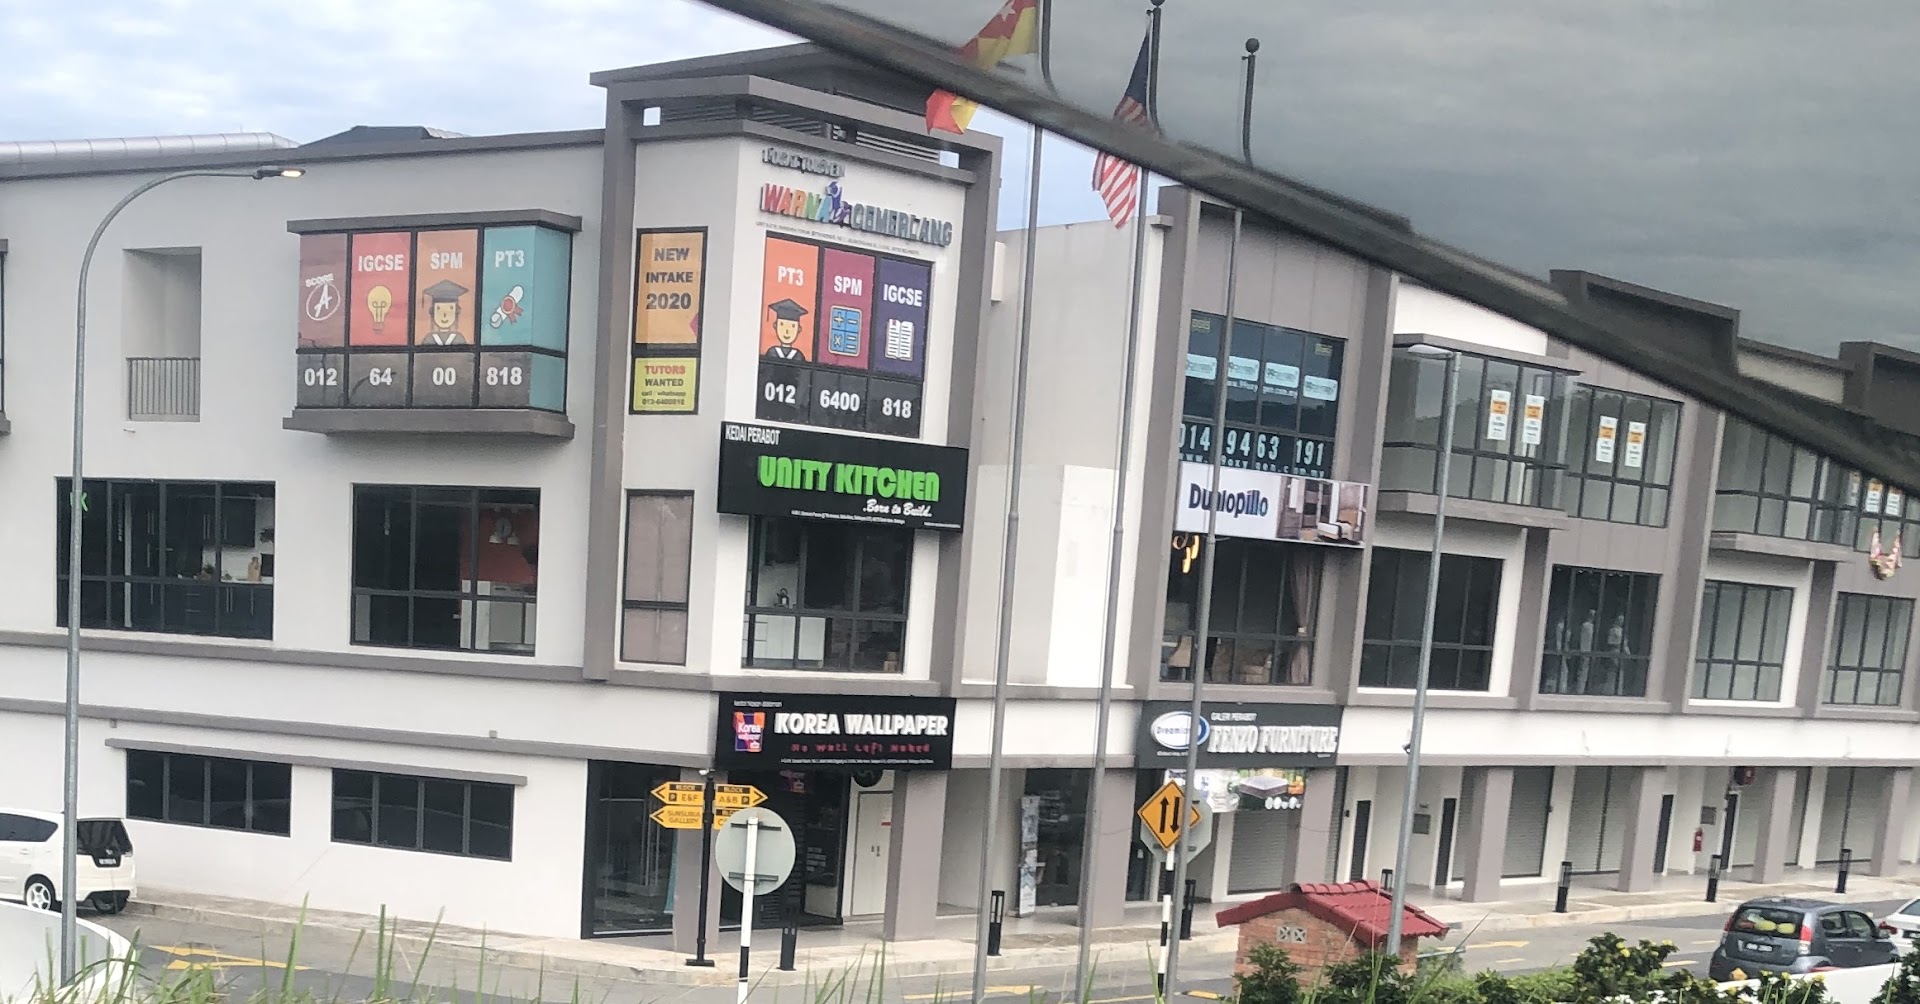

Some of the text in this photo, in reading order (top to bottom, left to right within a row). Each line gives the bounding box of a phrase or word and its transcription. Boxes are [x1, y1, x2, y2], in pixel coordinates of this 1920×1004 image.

[760, 183, 833, 223] WARNA
[851, 203, 953, 247] CEMERLANG
[358, 254, 404, 272] IGCSE
[430, 252, 463, 270] SPM
[495, 250, 525, 268] PT3
[654, 248, 690, 262] NEW
[305, 273, 335, 287] SCORE
[646, 272, 694, 284] INTAKE
[777, 265, 804, 287] PT3
[834, 275, 863, 297] SPM
[883, 283, 923, 307] IGCSE
[646, 293, 692, 310] 2020
[304, 366, 523, 386] 012 64 00 818
[645, 365, 686, 375] TUTORS
[645, 378, 684, 387] WANTED
[765, 382, 912, 418] 012 6400 818
[725, 424, 781, 445] KEDAI PERABOT
[1295, 439, 1325, 467] 191
[758, 455, 940, 502] UNITY KITCHEN
[891, 504, 902, 515] to
[737, 723, 762, 733] Korea
[774, 712, 948, 736] KOREA WALLPAPER
[1257, 725, 1338, 753] FURNITURE
